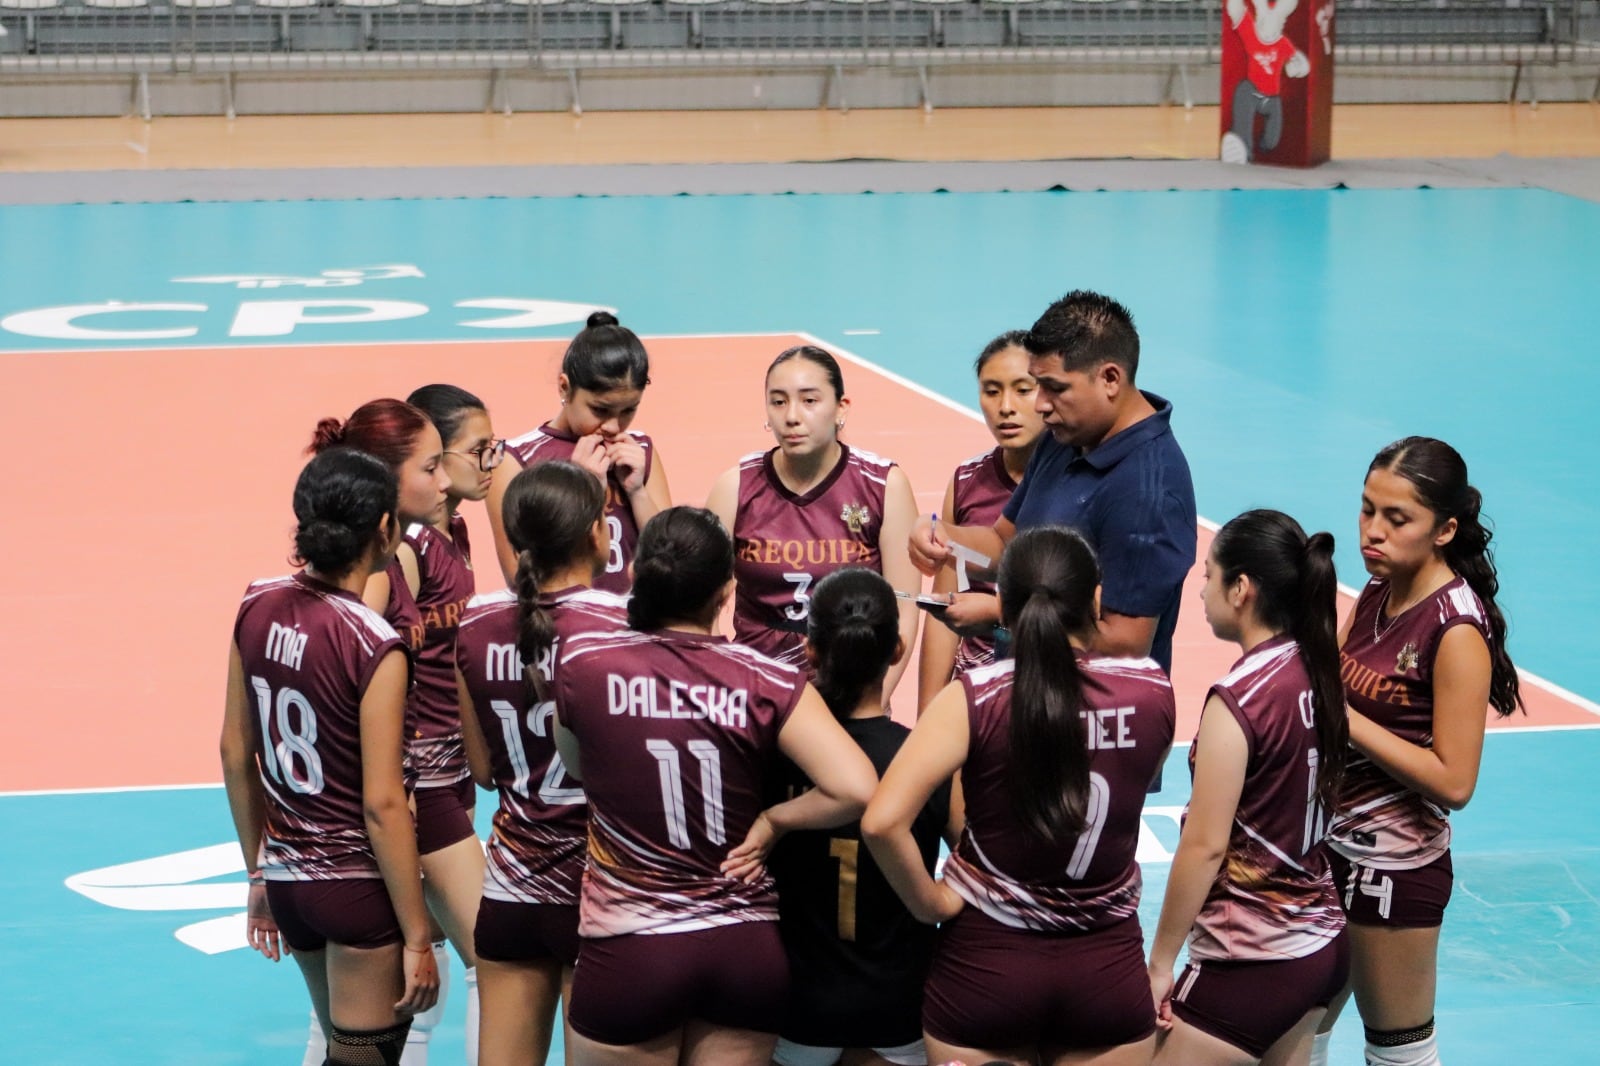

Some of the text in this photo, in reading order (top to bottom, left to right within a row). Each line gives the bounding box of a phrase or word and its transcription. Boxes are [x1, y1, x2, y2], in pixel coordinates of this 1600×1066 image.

[782, 572, 813, 621] 3
[251, 675, 325, 795] 18
[490, 700, 588, 805] 12
[607, 673, 747, 729] DALESKA
[646, 739, 727, 850] 11
[829, 837, 859, 941] 1
[1344, 862, 1393, 919] 14
